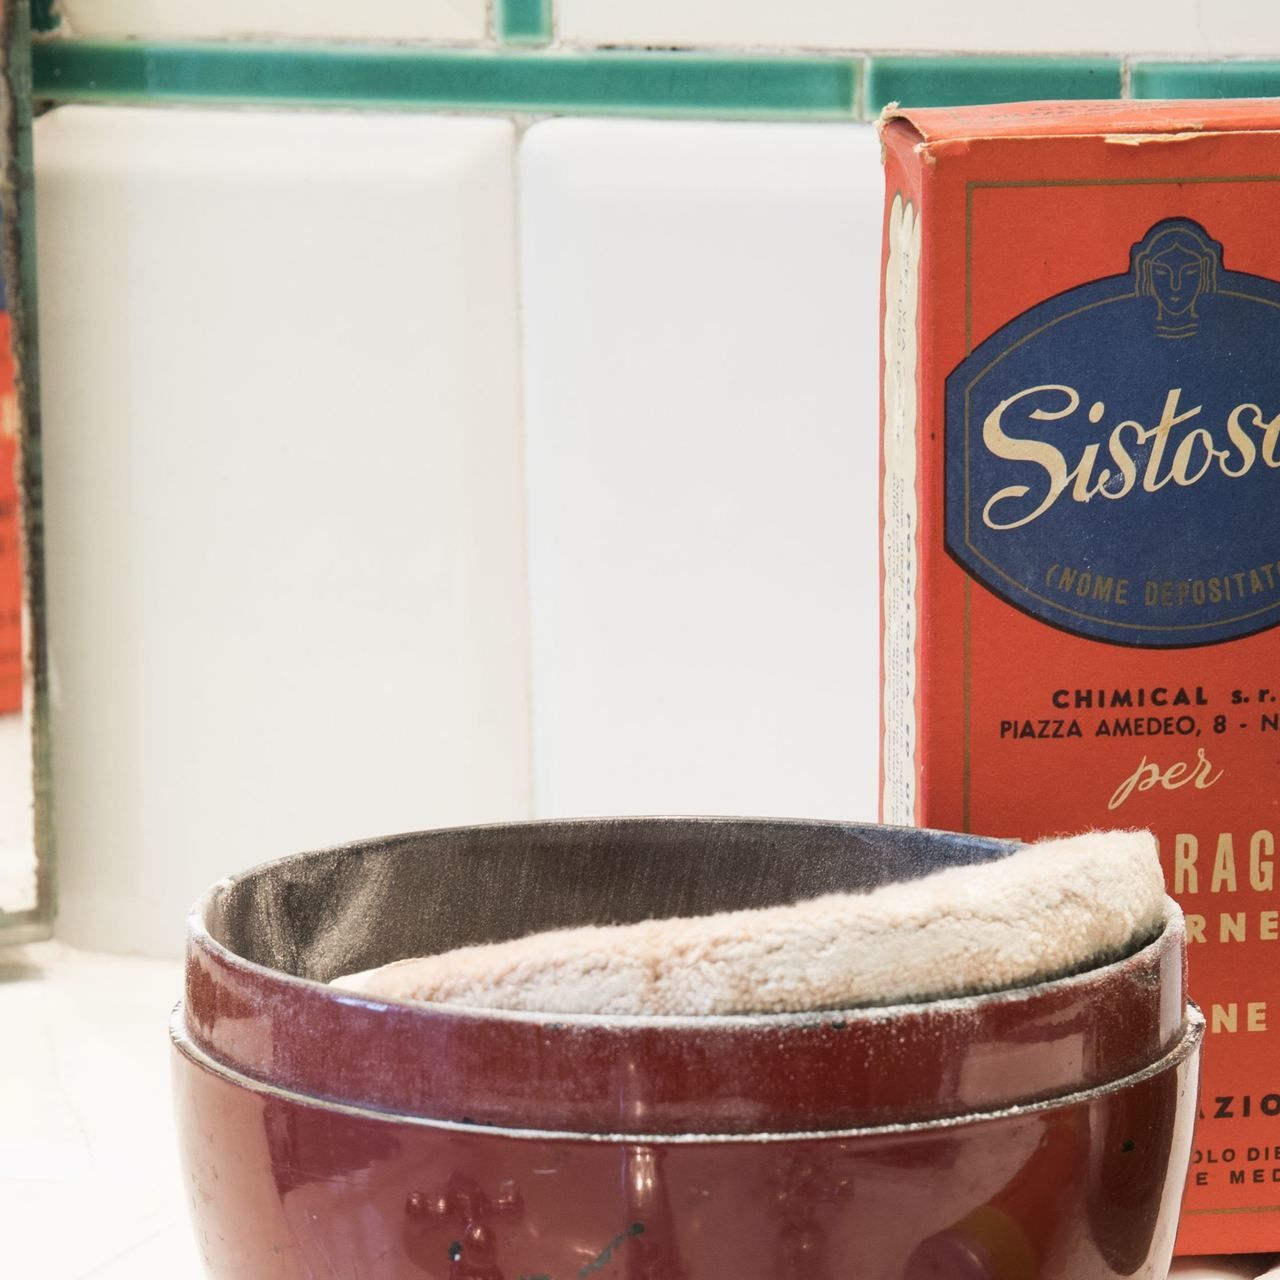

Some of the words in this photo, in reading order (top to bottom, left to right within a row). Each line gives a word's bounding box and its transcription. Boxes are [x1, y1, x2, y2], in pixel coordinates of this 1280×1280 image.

[1045, 564, 1129, 606] (NOME
[1052, 686, 1209, 709] CHIMICAL
[1000, 719, 1083, 740] PIAZZA
[1095, 714, 1202, 739] AMEDEO,
[1212, 714, 1228, 735] 8
[1107, 747, 1225, 811] per
